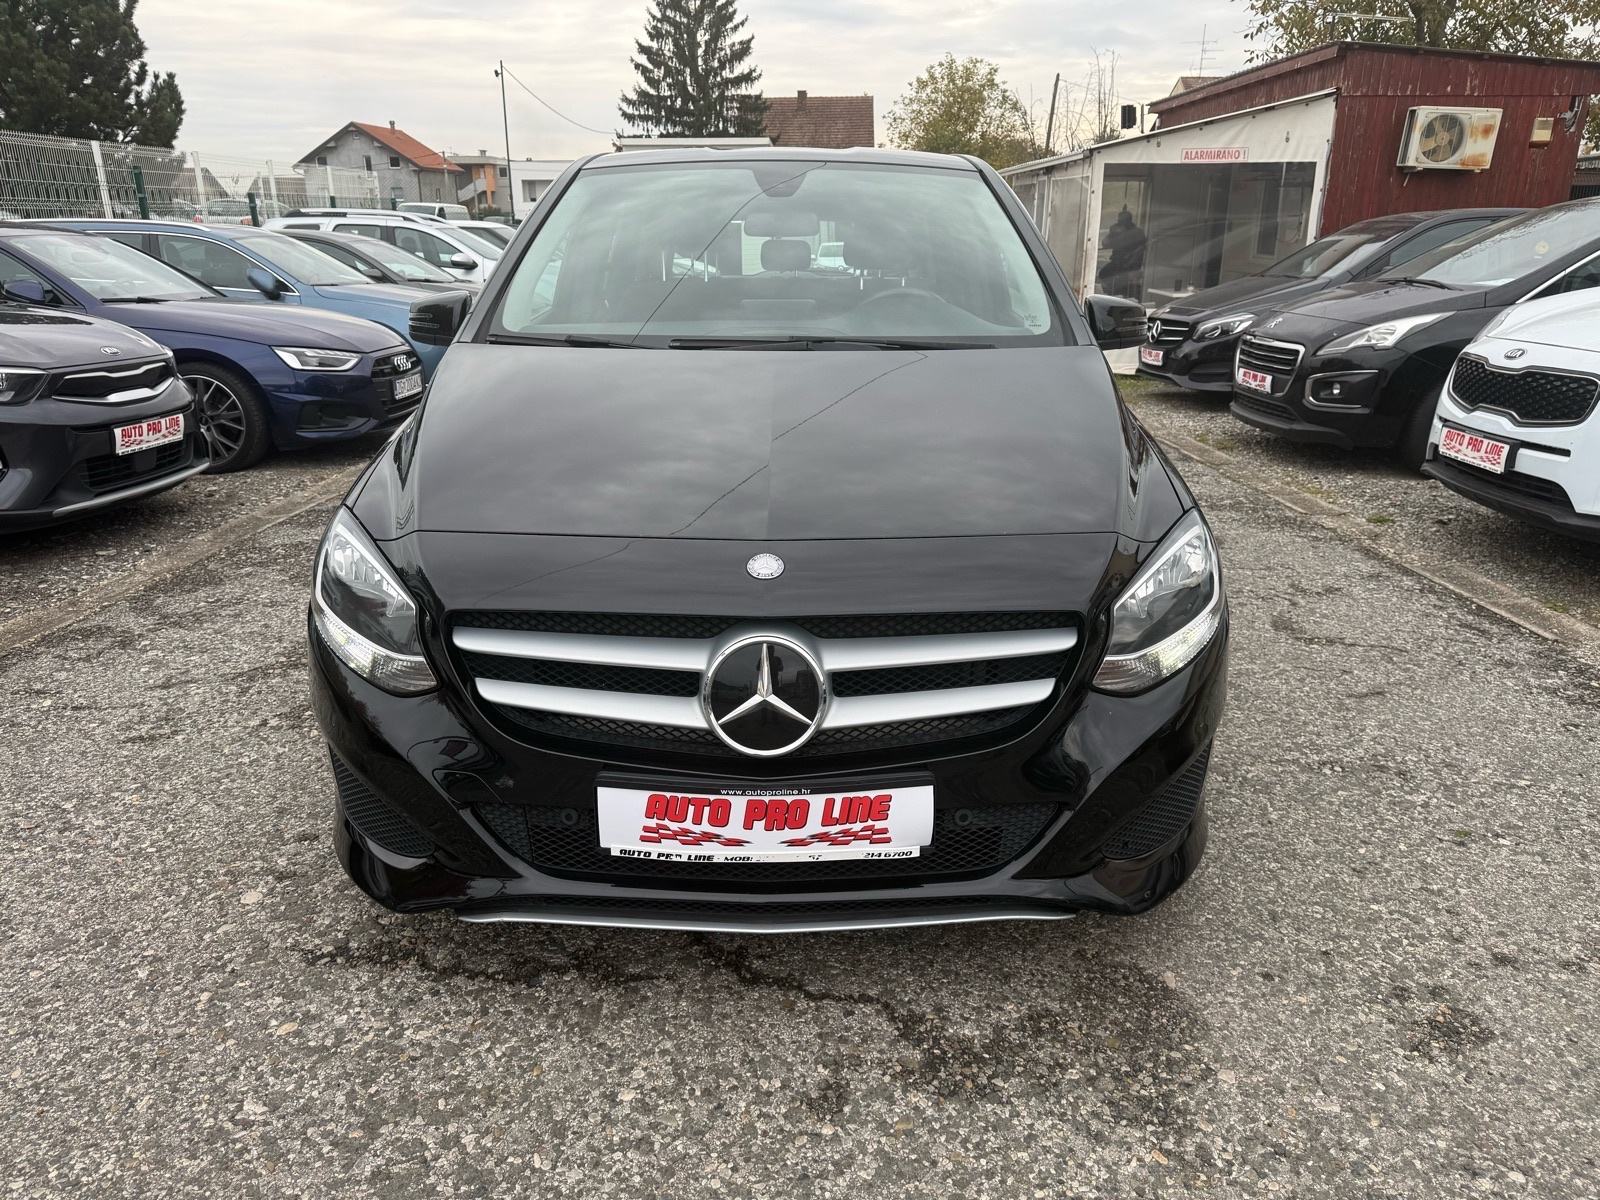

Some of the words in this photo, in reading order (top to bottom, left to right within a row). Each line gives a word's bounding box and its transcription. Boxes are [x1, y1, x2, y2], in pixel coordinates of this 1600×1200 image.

[1183, 149, 1241, 161] ALARMIRANO
[121, 424, 144, 439] AUTO
[146, 420, 162, 437] PRO
[165, 416, 180, 431] LINE
[1444, 429, 1466, 447] AUTO
[1466, 436, 1484, 454] PRO
[1484, 441, 1505, 457] LINE
[720, 788, 812, 797] www.autoproline.hr
[645, 794, 732, 828] AUTO
[743, 799, 810, 831] PRO
[821, 794, 892, 827] LINE
[619, 848, 652, 858] AUTO
[687, 854, 715, 862] LINE
[884, 850, 913, 858] 6700
